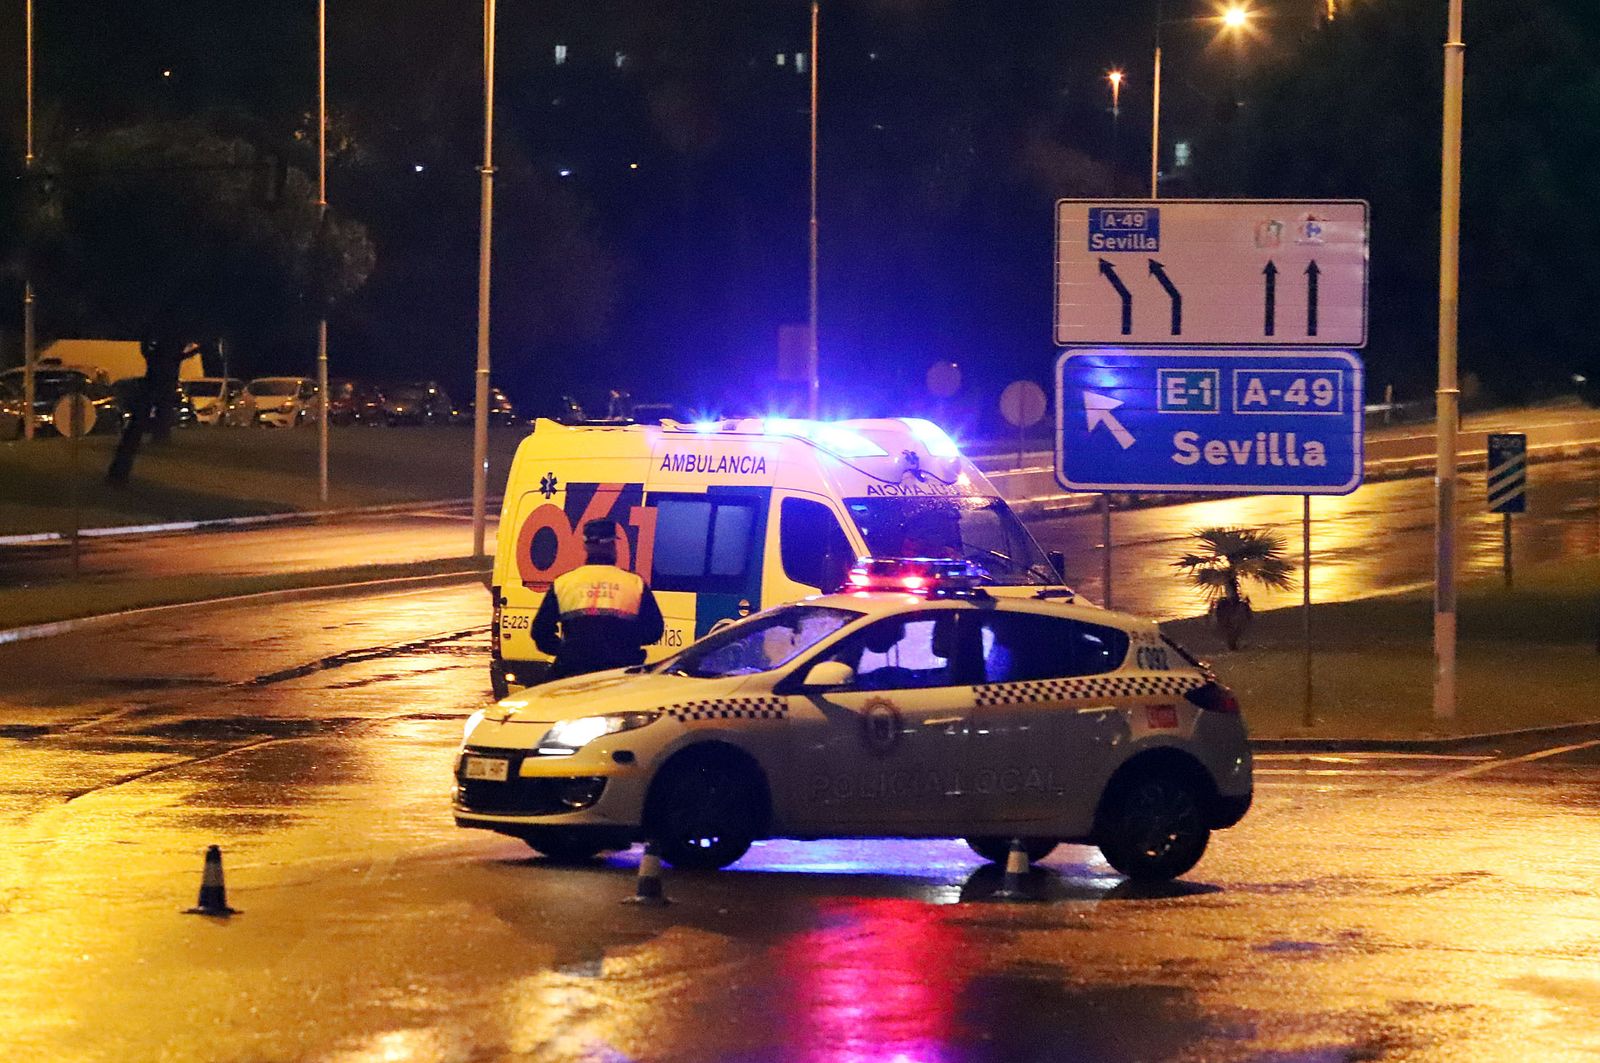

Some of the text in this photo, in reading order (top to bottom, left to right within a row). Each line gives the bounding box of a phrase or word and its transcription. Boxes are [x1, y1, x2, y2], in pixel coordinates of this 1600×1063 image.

[1104, 210, 1144, 227] A-49
[1091, 234, 1157, 250] Sevilla
[1166, 377, 1333, 406] E-1 A-49
[1171, 430, 1327, 467] Sevilla
[660, 453, 766, 474] AMBULANCIA
[502, 616, 529, 629] E-225
[955, 768, 1064, 794] LOCAL
